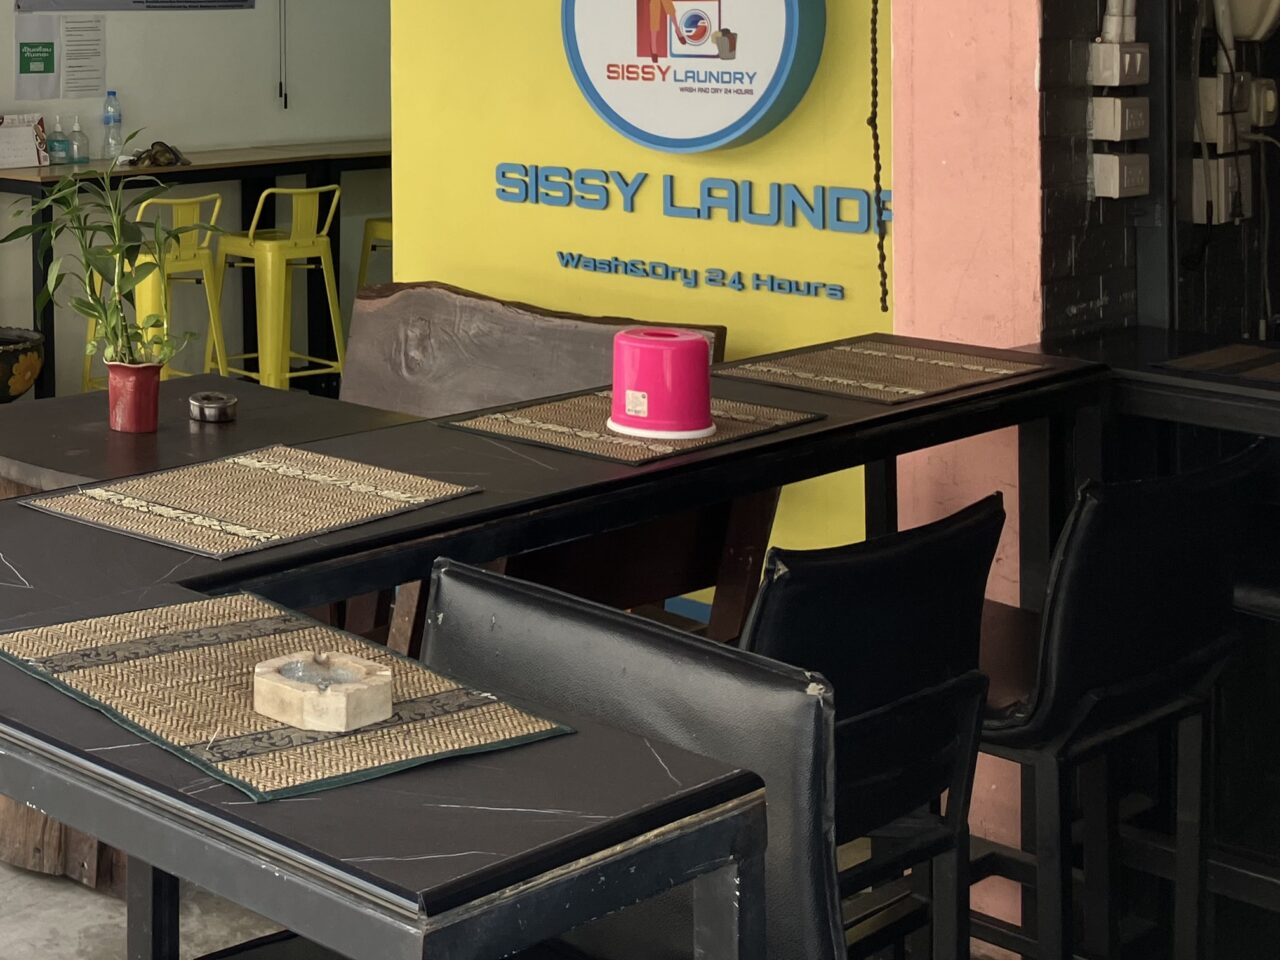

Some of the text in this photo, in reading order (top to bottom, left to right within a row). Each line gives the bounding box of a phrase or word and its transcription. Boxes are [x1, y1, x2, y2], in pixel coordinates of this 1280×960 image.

[606, 63, 757, 85] SISSY LAUNDRY
[495, 161, 649, 213] SISSY
[704, 268, 746, 291] 24
[752, 273, 845, 300] Hours
